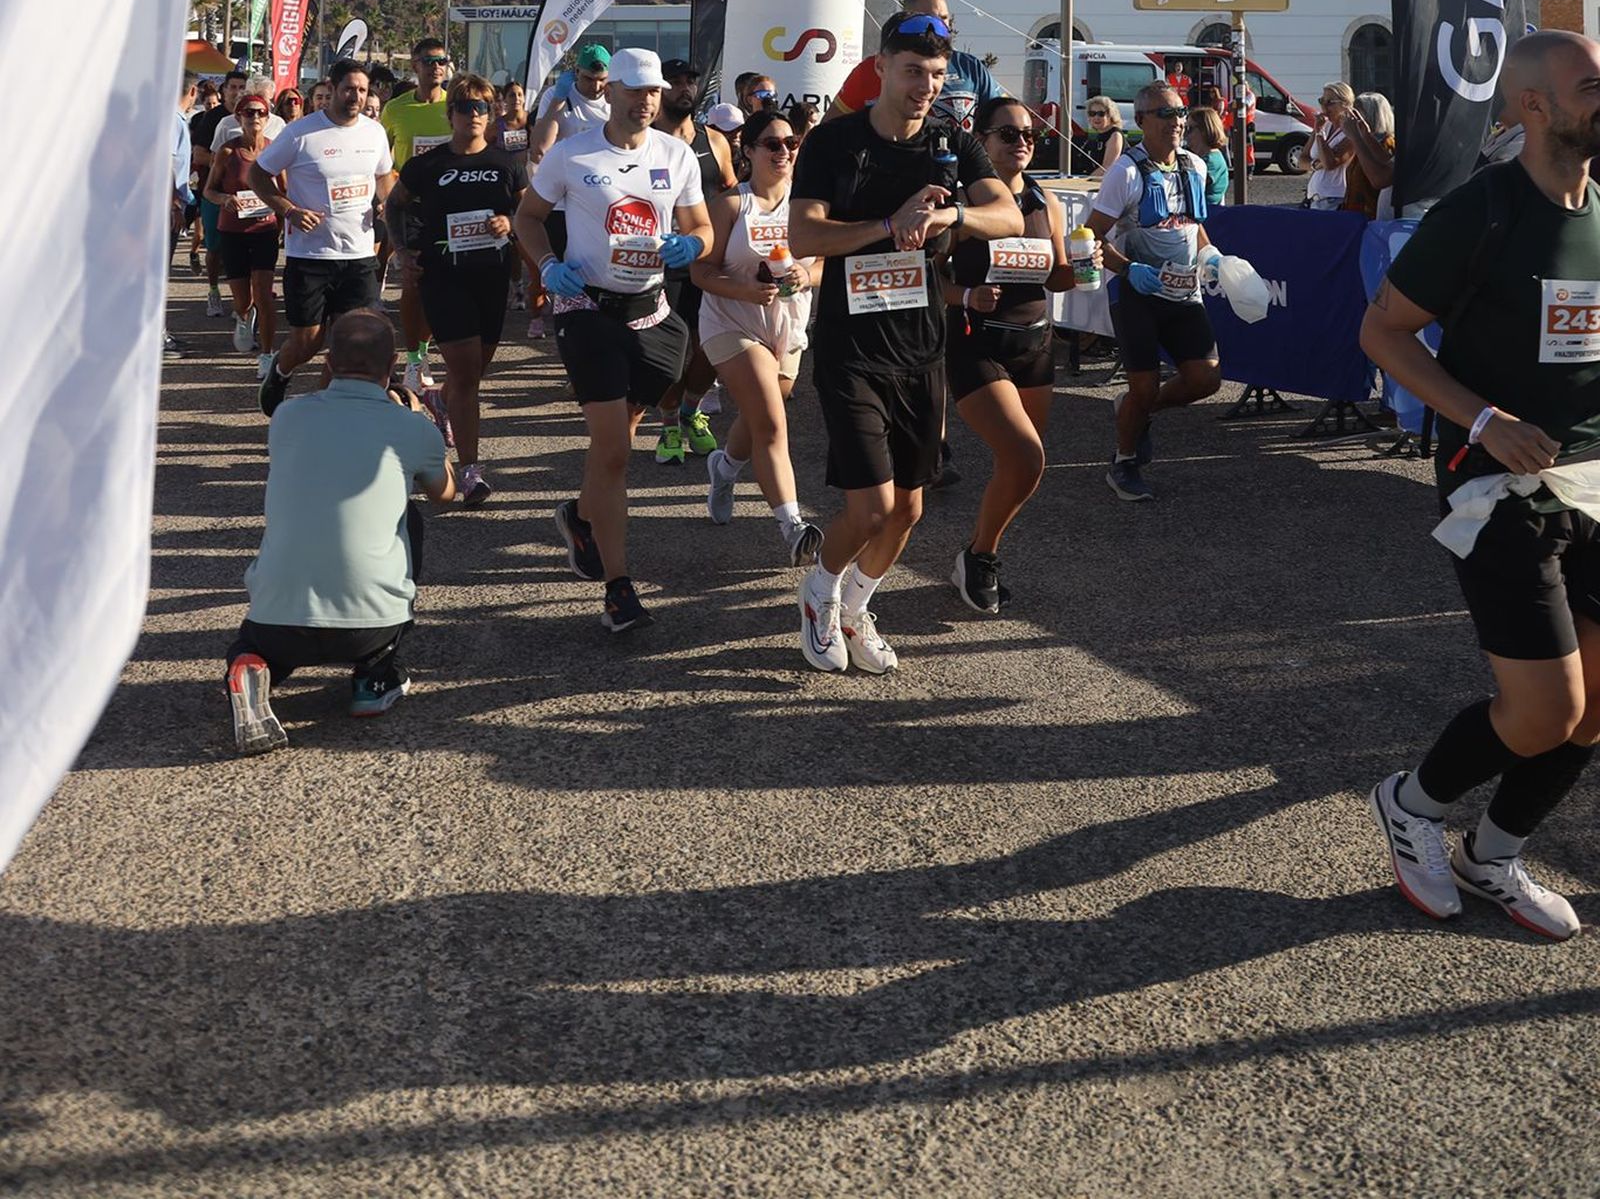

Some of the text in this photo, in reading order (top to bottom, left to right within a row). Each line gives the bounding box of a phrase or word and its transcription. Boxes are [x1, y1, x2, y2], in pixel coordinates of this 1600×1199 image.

[615, 210, 653, 229] PONLE
[997, 253, 1048, 269] 24938
[856, 270, 917, 291] 24937
